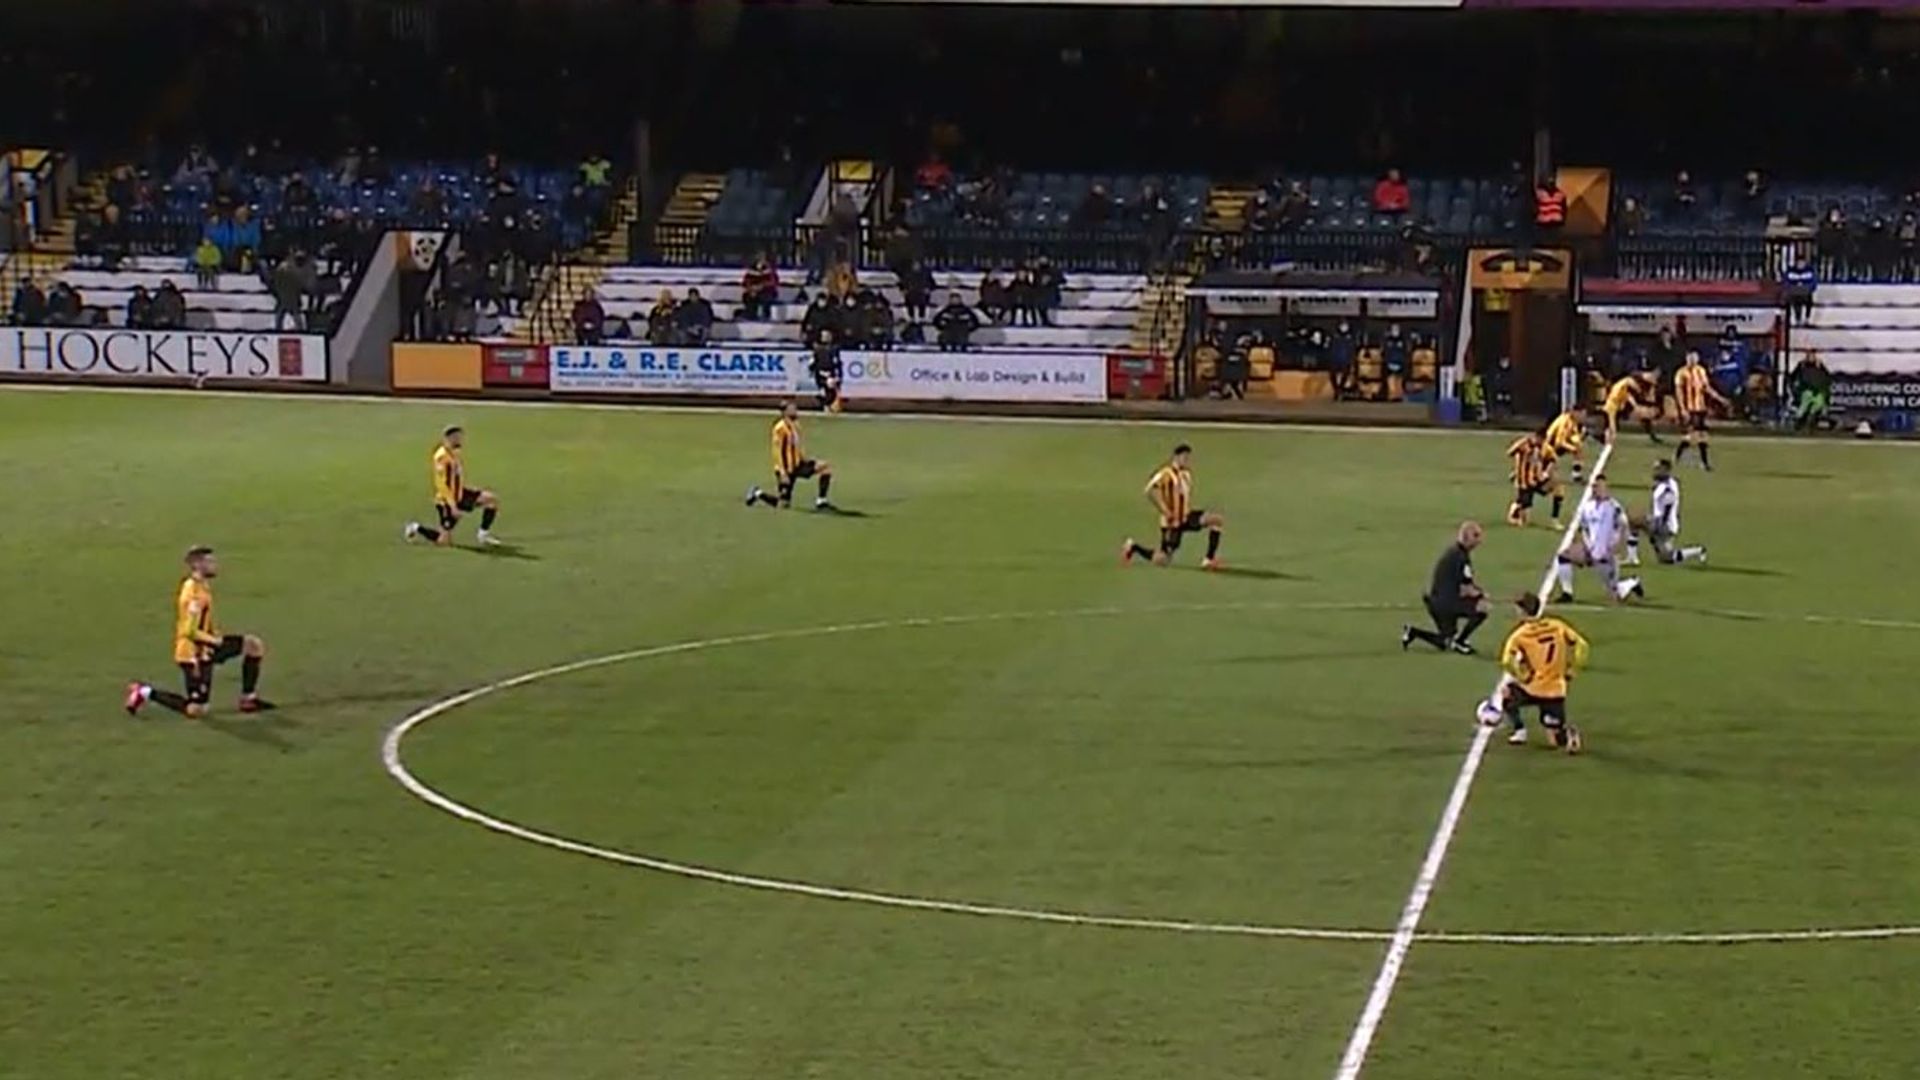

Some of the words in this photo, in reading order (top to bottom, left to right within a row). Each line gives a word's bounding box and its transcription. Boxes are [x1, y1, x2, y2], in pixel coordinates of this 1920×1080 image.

[16, 330, 271, 377] HOCKEYS
[556, 350, 598, 369] E.J.
[607, 351, 627, 370] &
[640, 352, 688, 371] R.E.
[697, 352, 786, 372] CLARK
[910, 368, 950, 382] Office
[954, 369, 962, 382] &
[993, 370, 1038, 385] Design
[1041, 371, 1049, 383] &
[1054, 371, 1086, 384] Build
[1830, 382, 1901, 395] DELIVERING
[1830, 395, 1890, 407] PROJECTS
[1892, 396, 1905, 407] IN
[1537, 635, 1556, 665] 7
